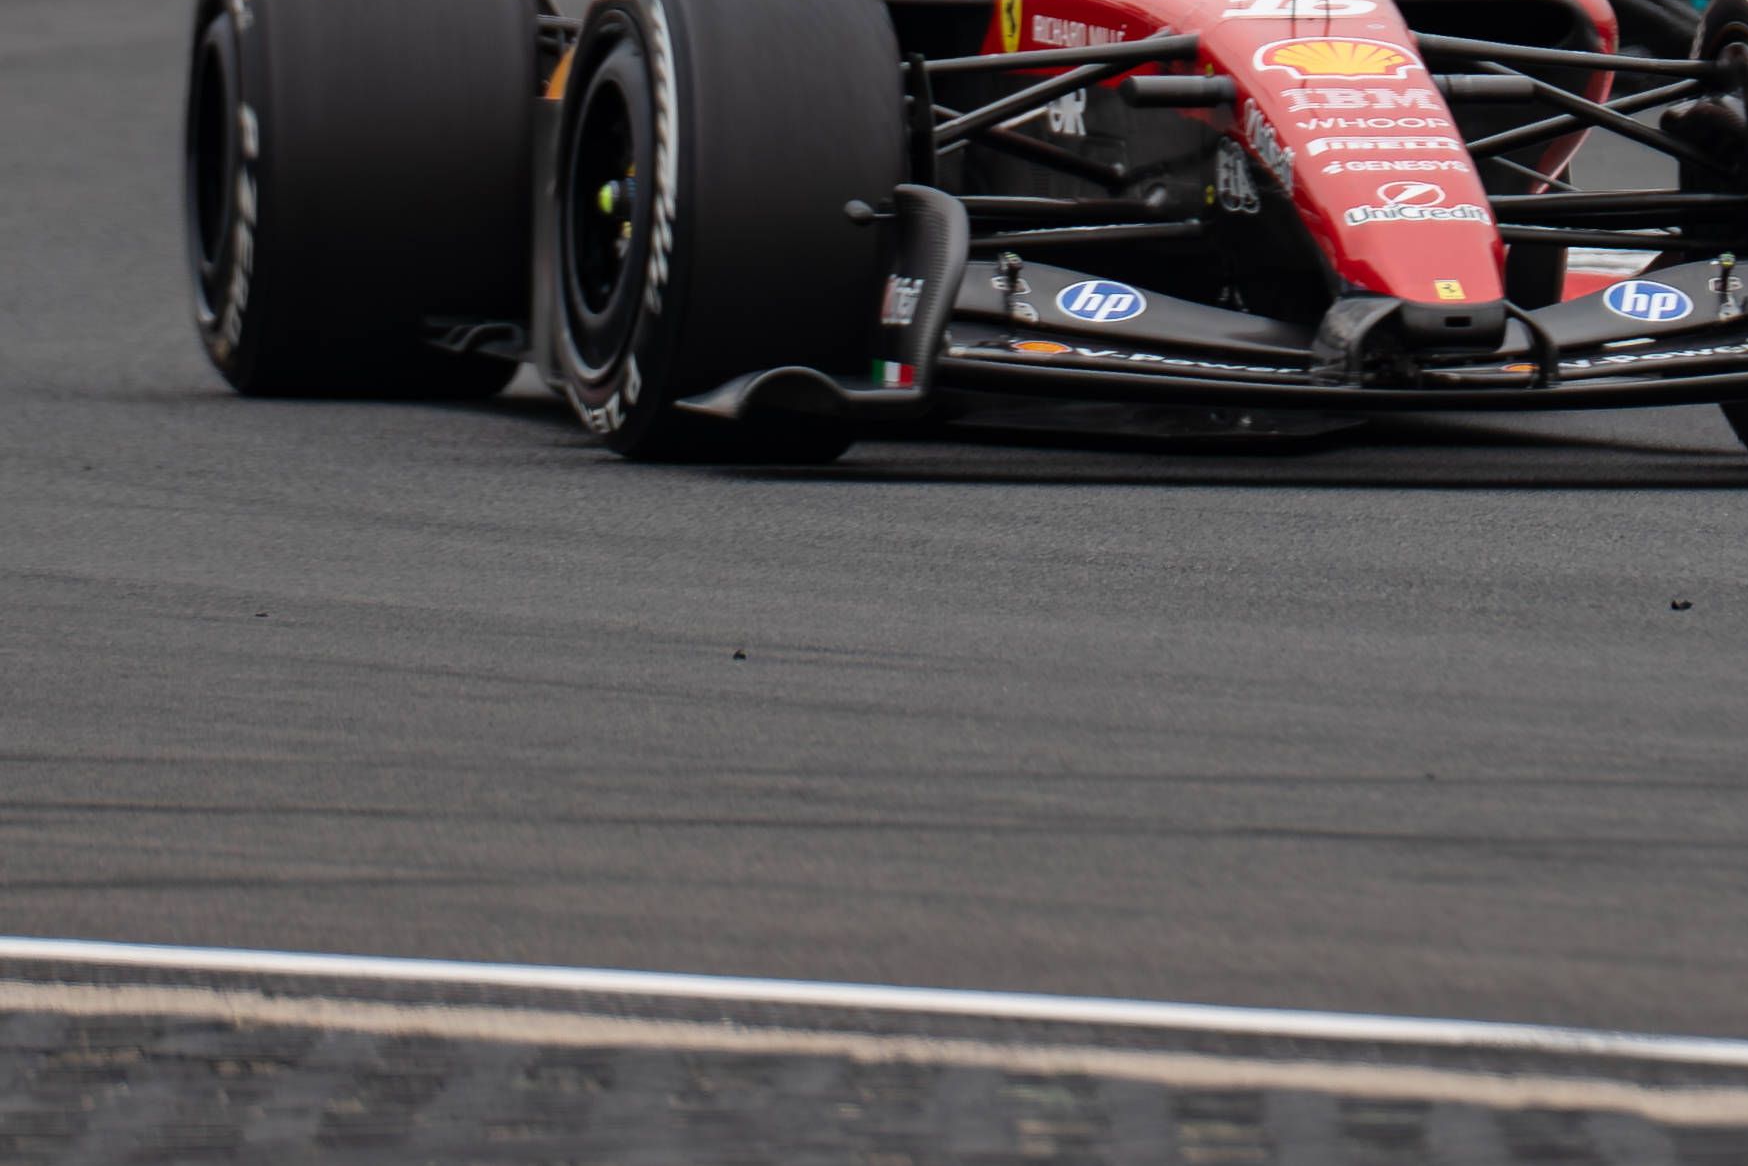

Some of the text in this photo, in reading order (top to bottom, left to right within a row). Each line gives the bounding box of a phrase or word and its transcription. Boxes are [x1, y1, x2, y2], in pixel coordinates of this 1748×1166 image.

[1281, 88, 1442, 112] IBM
[1296, 116, 1452, 131] WHOOP
[1304, 136, 1461, 157] PIRELLI
[1345, 160, 1471, 173] GENESYS
[1344, 203, 1493, 226] UniCredit
[1076, 281, 1135, 320] hp
[1620, 281, 1678, 321] hp
